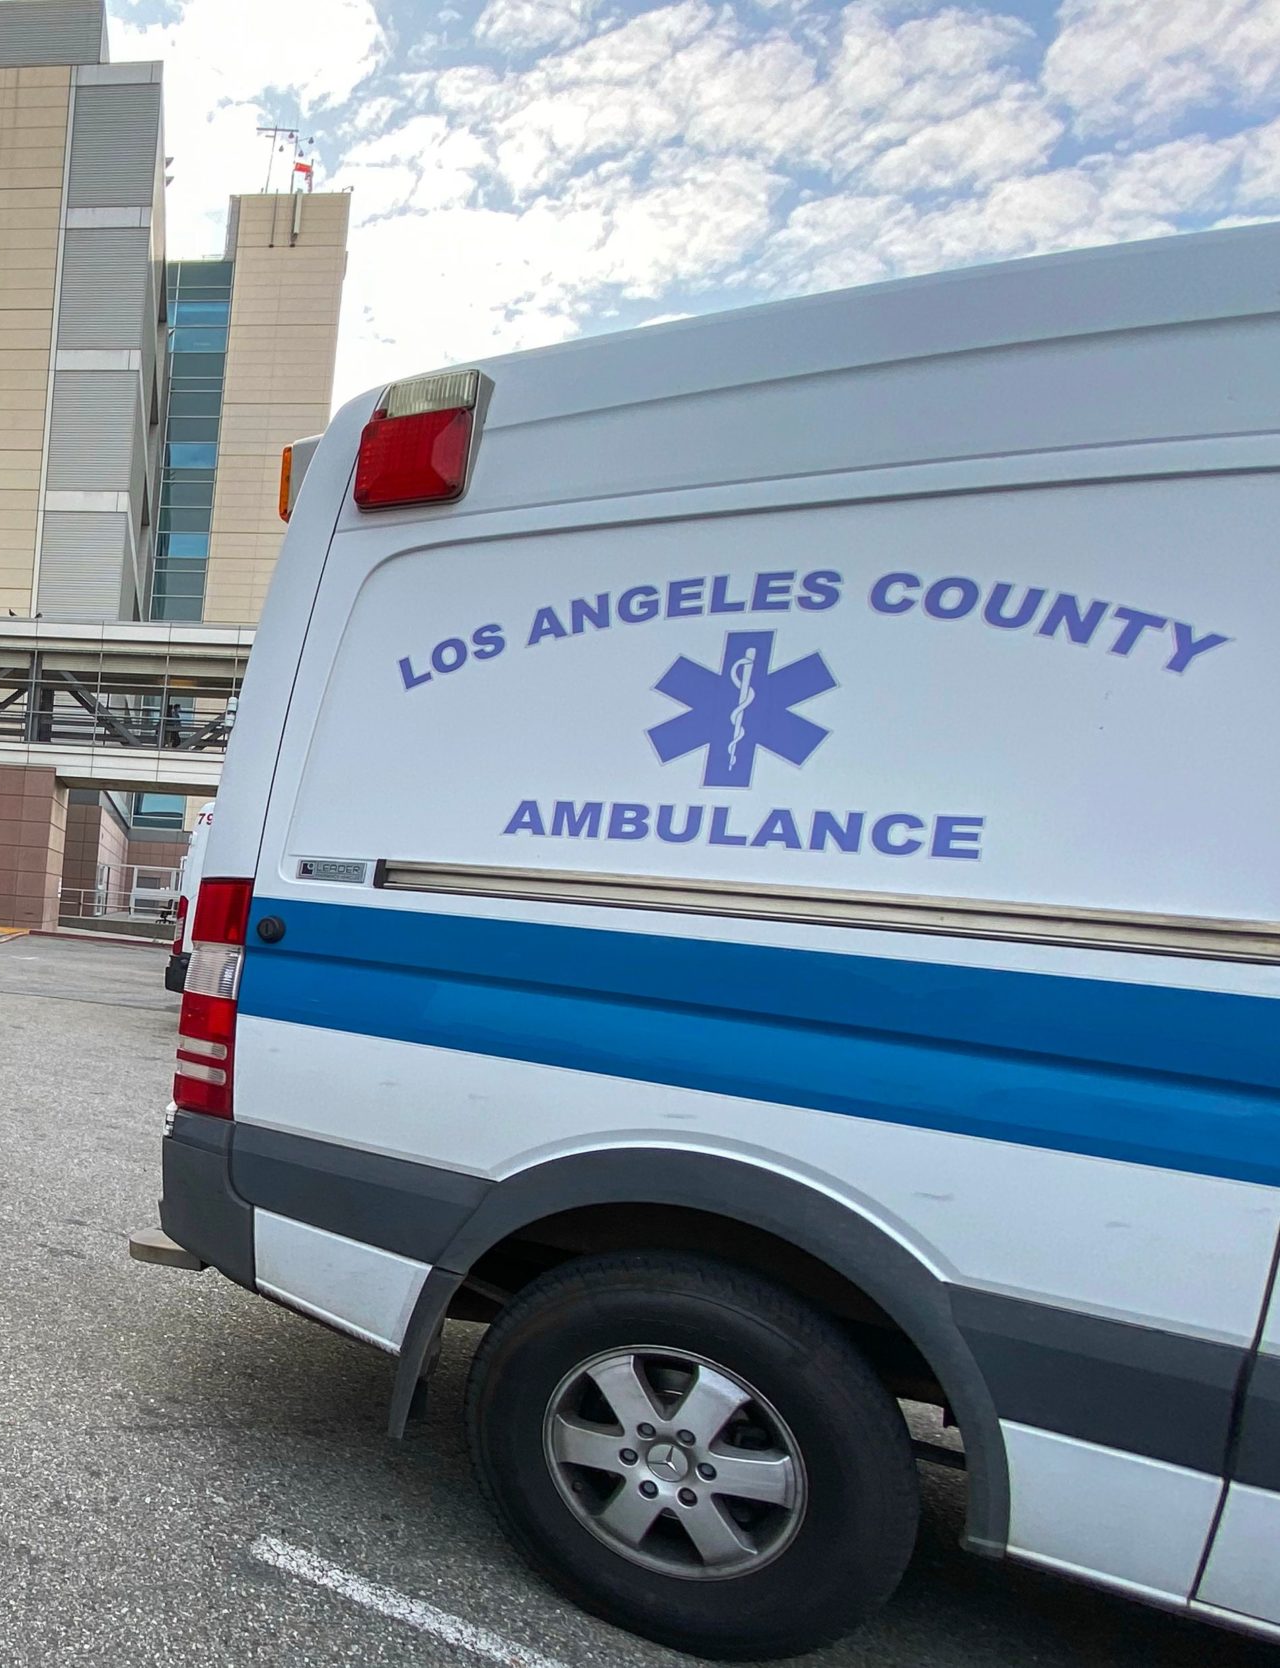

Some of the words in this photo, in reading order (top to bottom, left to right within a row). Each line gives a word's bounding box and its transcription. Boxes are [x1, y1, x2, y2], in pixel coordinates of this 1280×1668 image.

[399, 624, 506, 690] LOS
[526, 570, 843, 647] ANGELES
[869, 572, 1233, 674] COUNTY
[500, 800, 985, 860] AMBULANCE
[316, 863, 361, 873] LEADER
